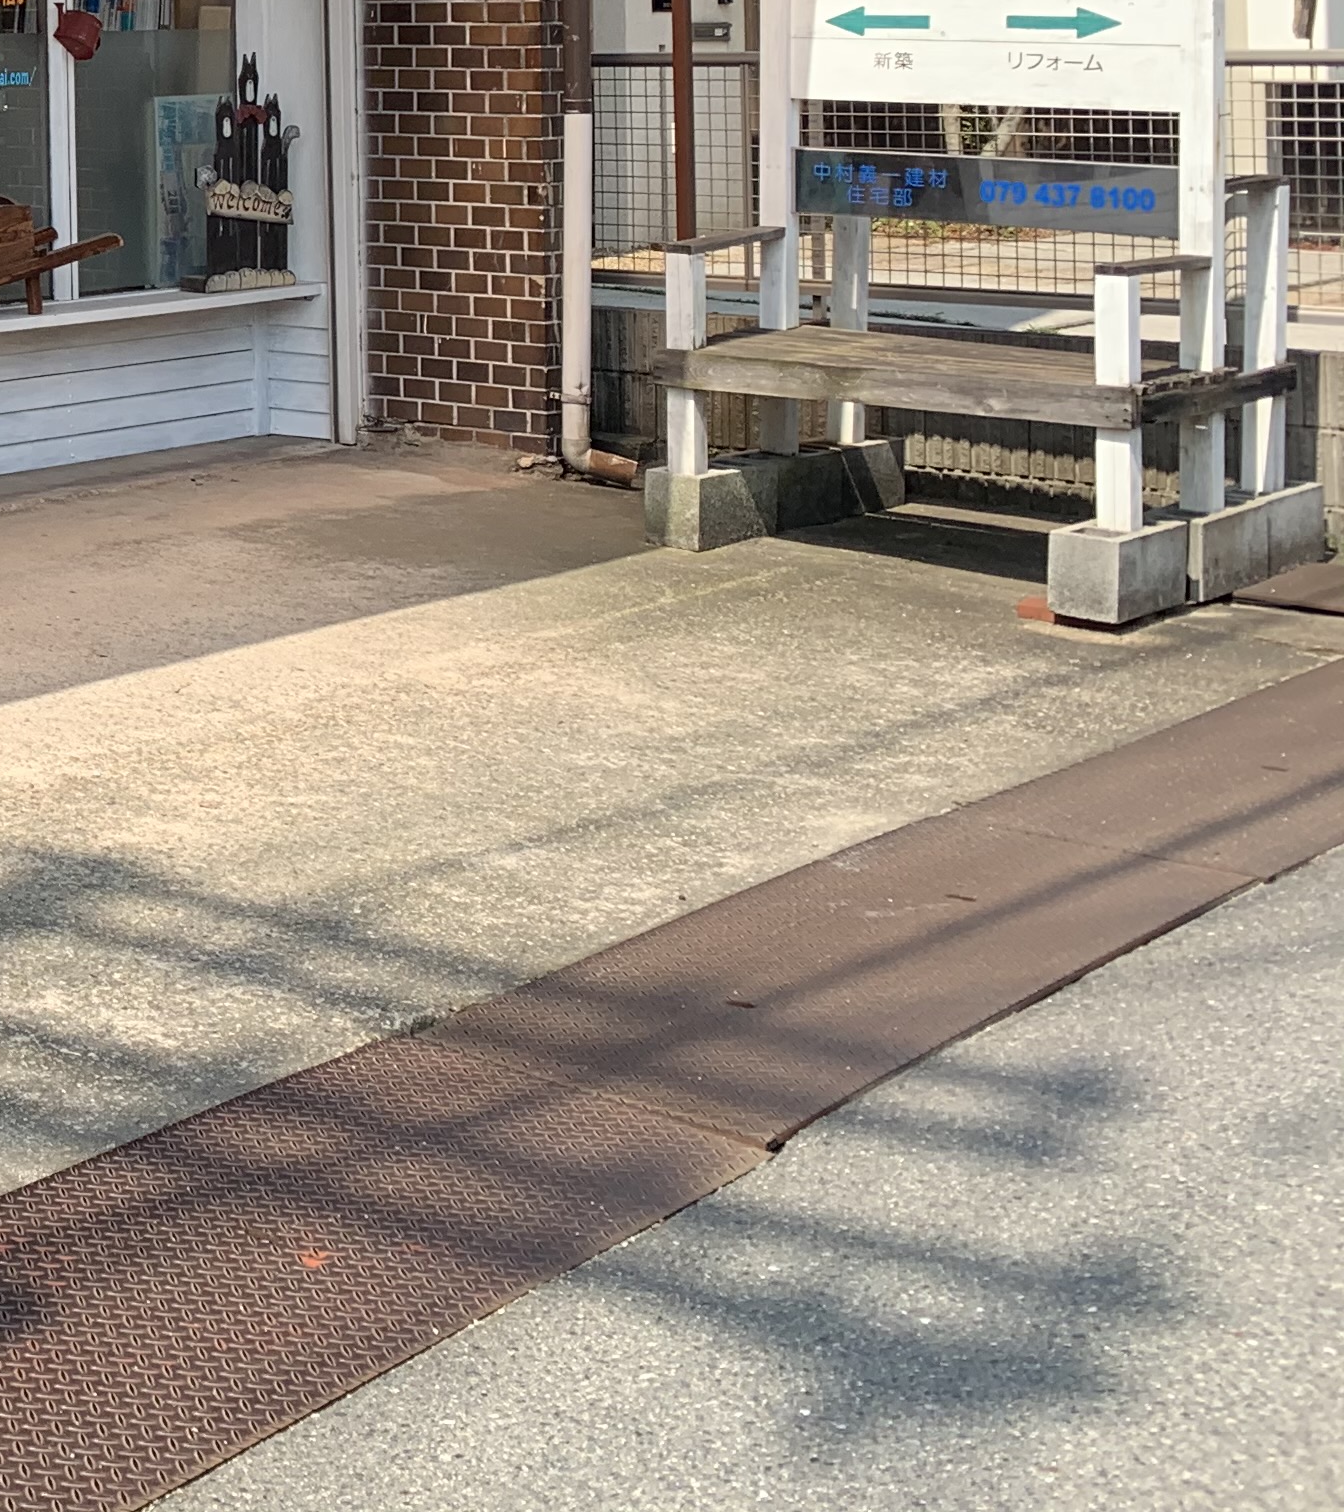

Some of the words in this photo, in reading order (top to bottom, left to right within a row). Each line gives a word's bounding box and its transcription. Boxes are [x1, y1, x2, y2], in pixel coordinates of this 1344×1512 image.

[873, 52, 914, 71] 新築
[1007, 53, 1104, 73] リフォーム
[813, 163, 950, 189] 中村義一建材
[846, 188, 913, 207] 住宅部
[979, 180, 1028, 205] 079
[1034, 182, 1082, 208] 437
[1089, 186, 1156, 212] 8100
